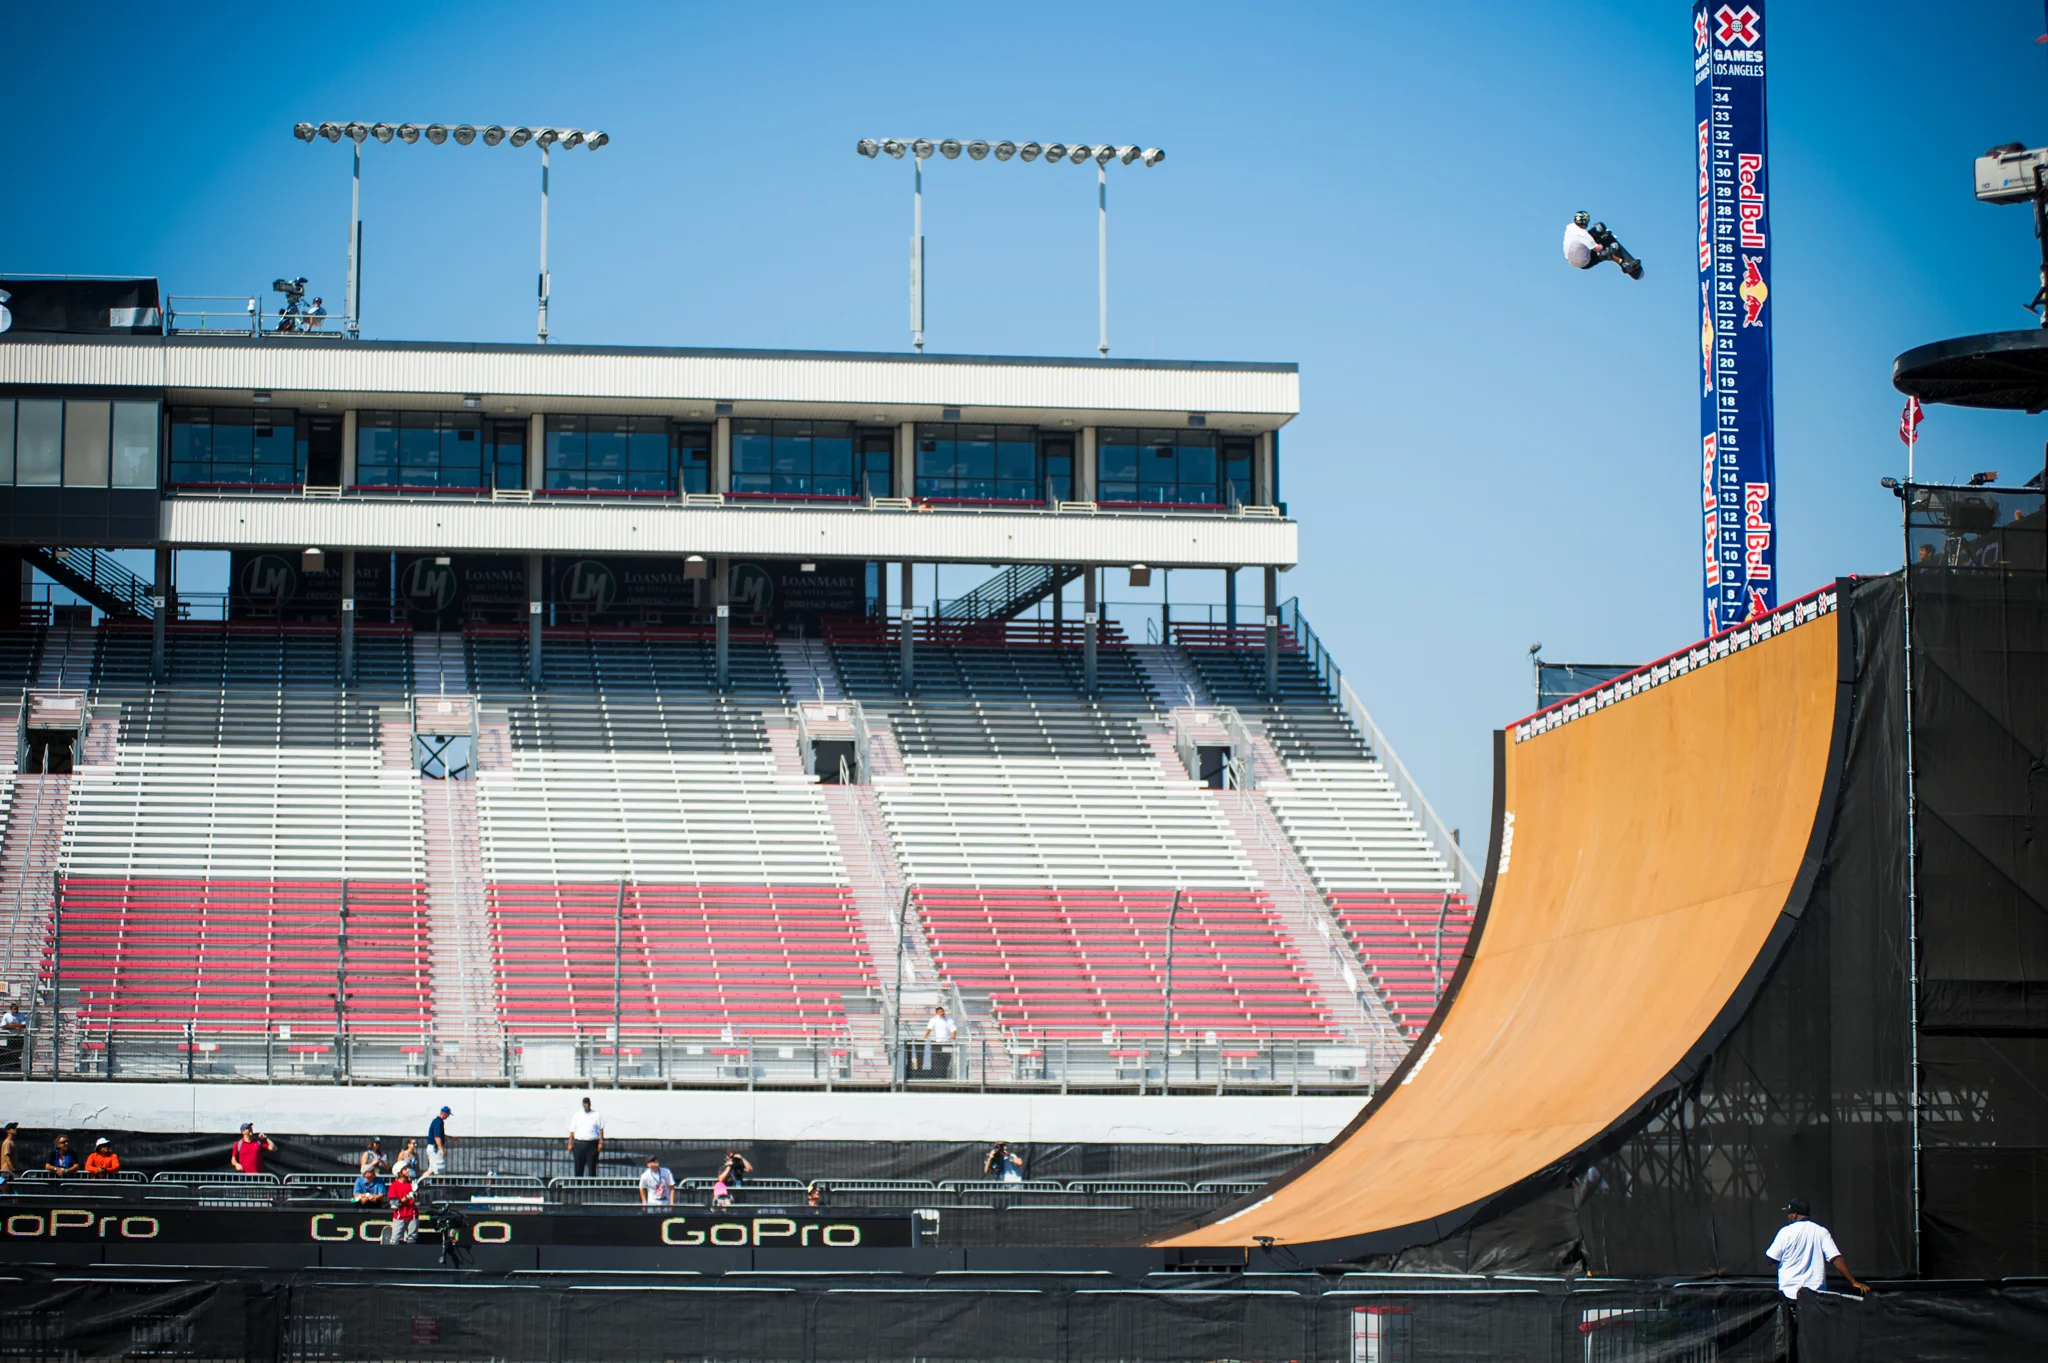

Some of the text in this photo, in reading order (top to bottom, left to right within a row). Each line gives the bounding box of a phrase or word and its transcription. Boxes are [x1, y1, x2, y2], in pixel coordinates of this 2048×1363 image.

[1714, 48, 1763, 62] GAMES
[1714, 64, 1728, 75] LOS
[1728, 64, 1764, 76] ANGELES
[1715, 93, 1729, 102] 34
[1716, 112, 1729, 120] 33
[1716, 131, 1729, 139] 32
[1717, 150, 1729, 158] 31
[1717, 168, 1731, 177] 30
[1718, 187, 1731, 196] 29
[1738, 153, 1766, 248] Red Bull
[1718, 206, 1731, 215] 28
[1719, 225, 1732, 233] 27
[1719, 244, 1732, 253] 26
[1719, 263, 1733, 272] 25
[1719, 282, 1733, 291] 24
[1720, 301, 1733, 310] 23
[1720, 320, 1733, 329] 22
[1720, 339, 1732, 348] 21
[1721, 358, 1734, 367] 20
[1721, 378, 1734, 386] 19
[1722, 397, 1735, 406] 18
[1722, 416, 1735, 425] 17
[1723, 435, 1736, 444] 16
[1724, 454, 1736, 463] 15
[1723, 473, 1737, 482] 14
[1723, 493, 1737, 502] 13
[1704, 432, 1720, 588] Red Bull
[1724, 512, 1737, 521] 12
[1745, 482, 1771, 580] Red Bull
[1724, 532, 1736, 541] 11
[1724, 551, 1738, 560] 10
[1727, 570, 1734, 579] 9
[1728, 590, 1735, 599] 8
[1728, 609, 1735, 618] 7
[0, 1209, 159, 1238] oPro
[311, 1213, 511, 1244] Goo
[661, 1217, 861, 1246] GoPro
